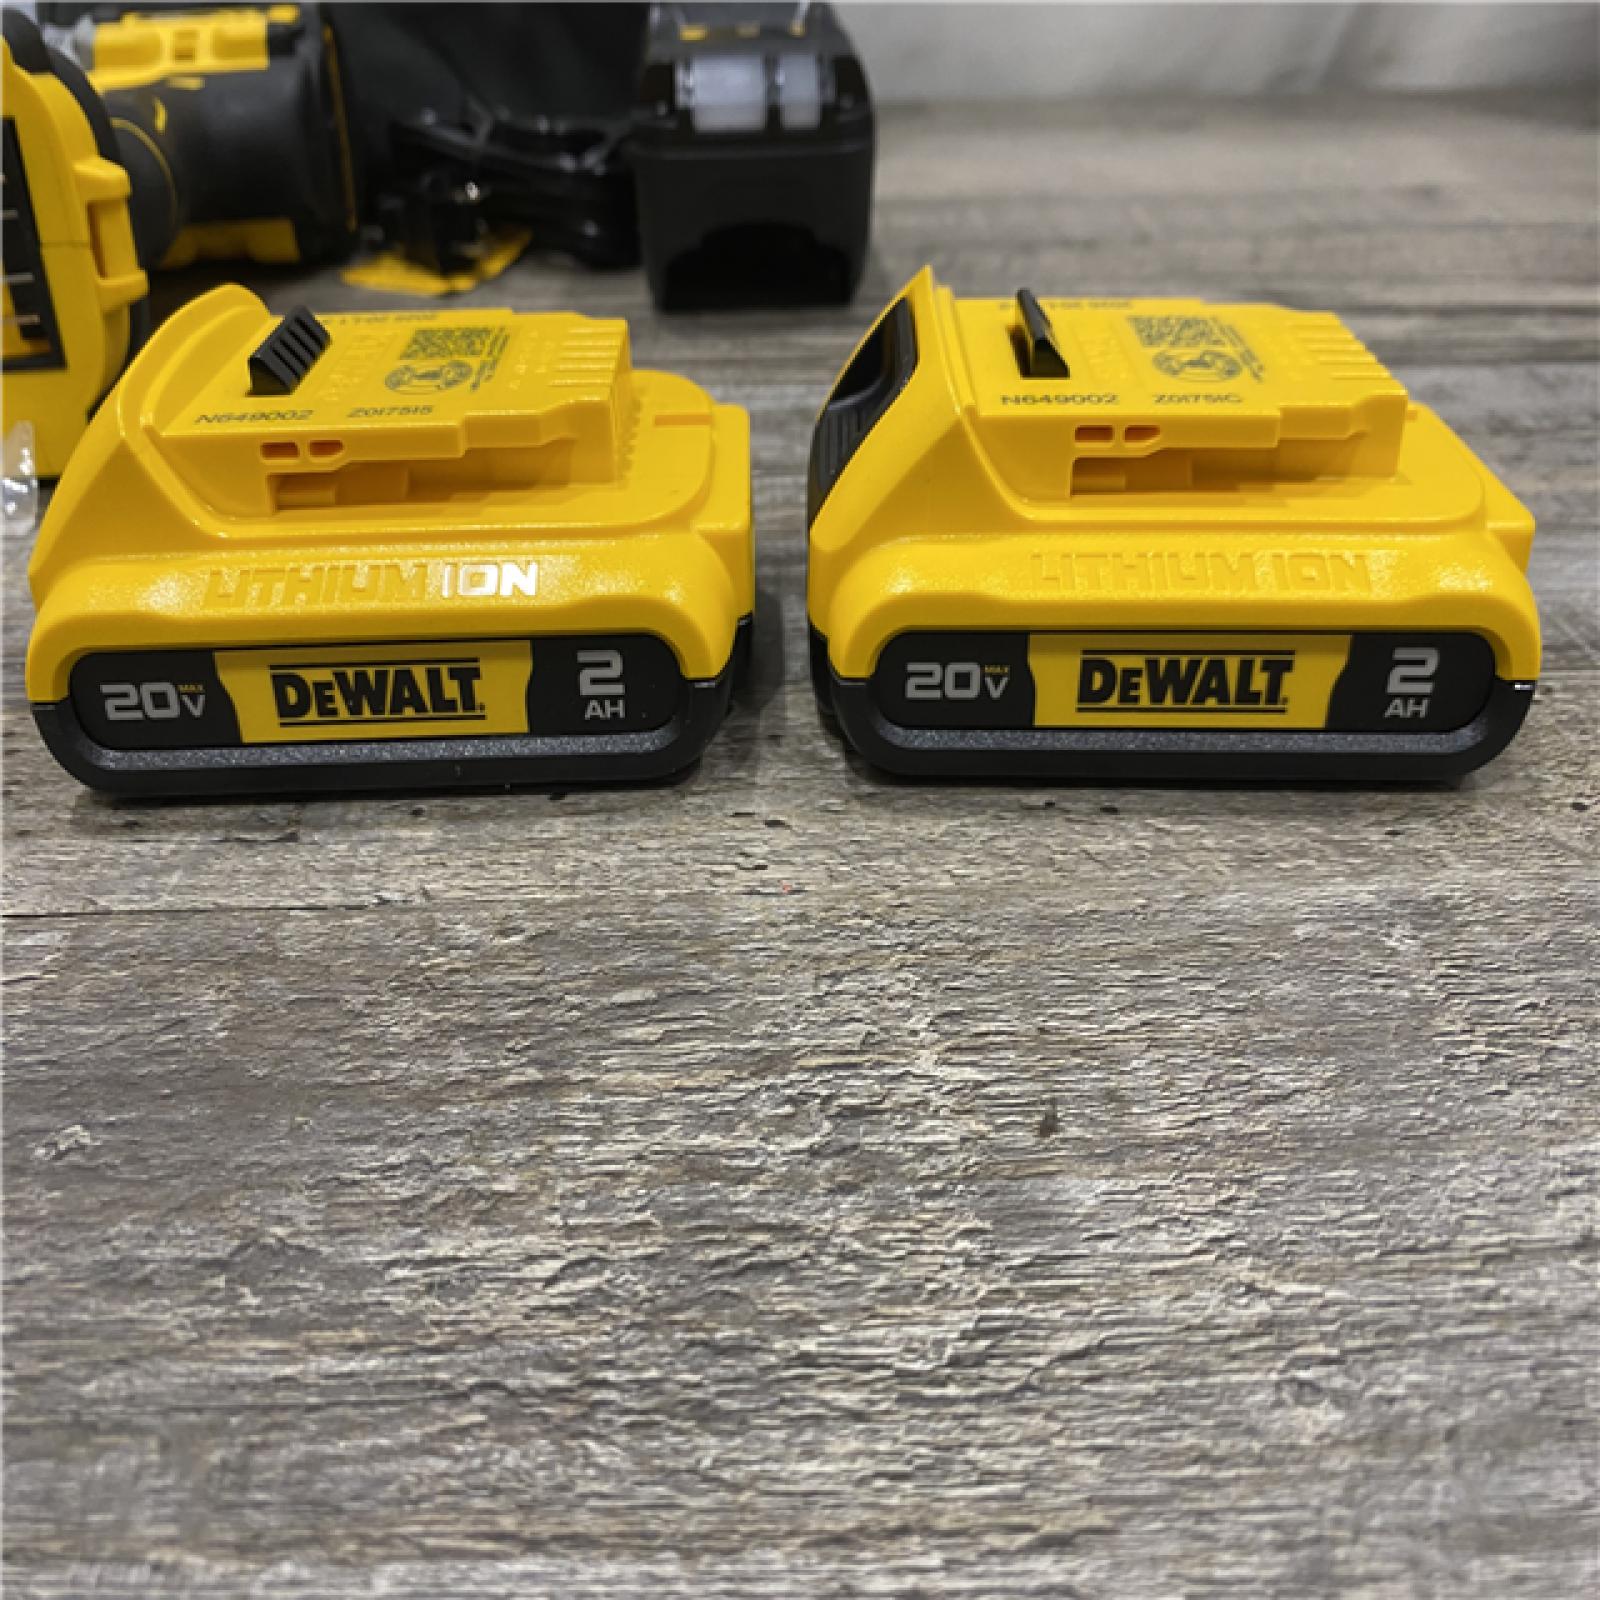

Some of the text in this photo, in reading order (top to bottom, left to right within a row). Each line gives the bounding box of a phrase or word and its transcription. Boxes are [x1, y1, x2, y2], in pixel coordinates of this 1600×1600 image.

[204, 561, 538, 608] LITHIUM ION
[1030, 551, 1373, 592] LITHIUM ION
[577, 649, 625, 696] 2
[1387, 646, 1439, 695] 2
[584, 699, 626, 720] AH
[1383, 697, 1429, 719] AH
